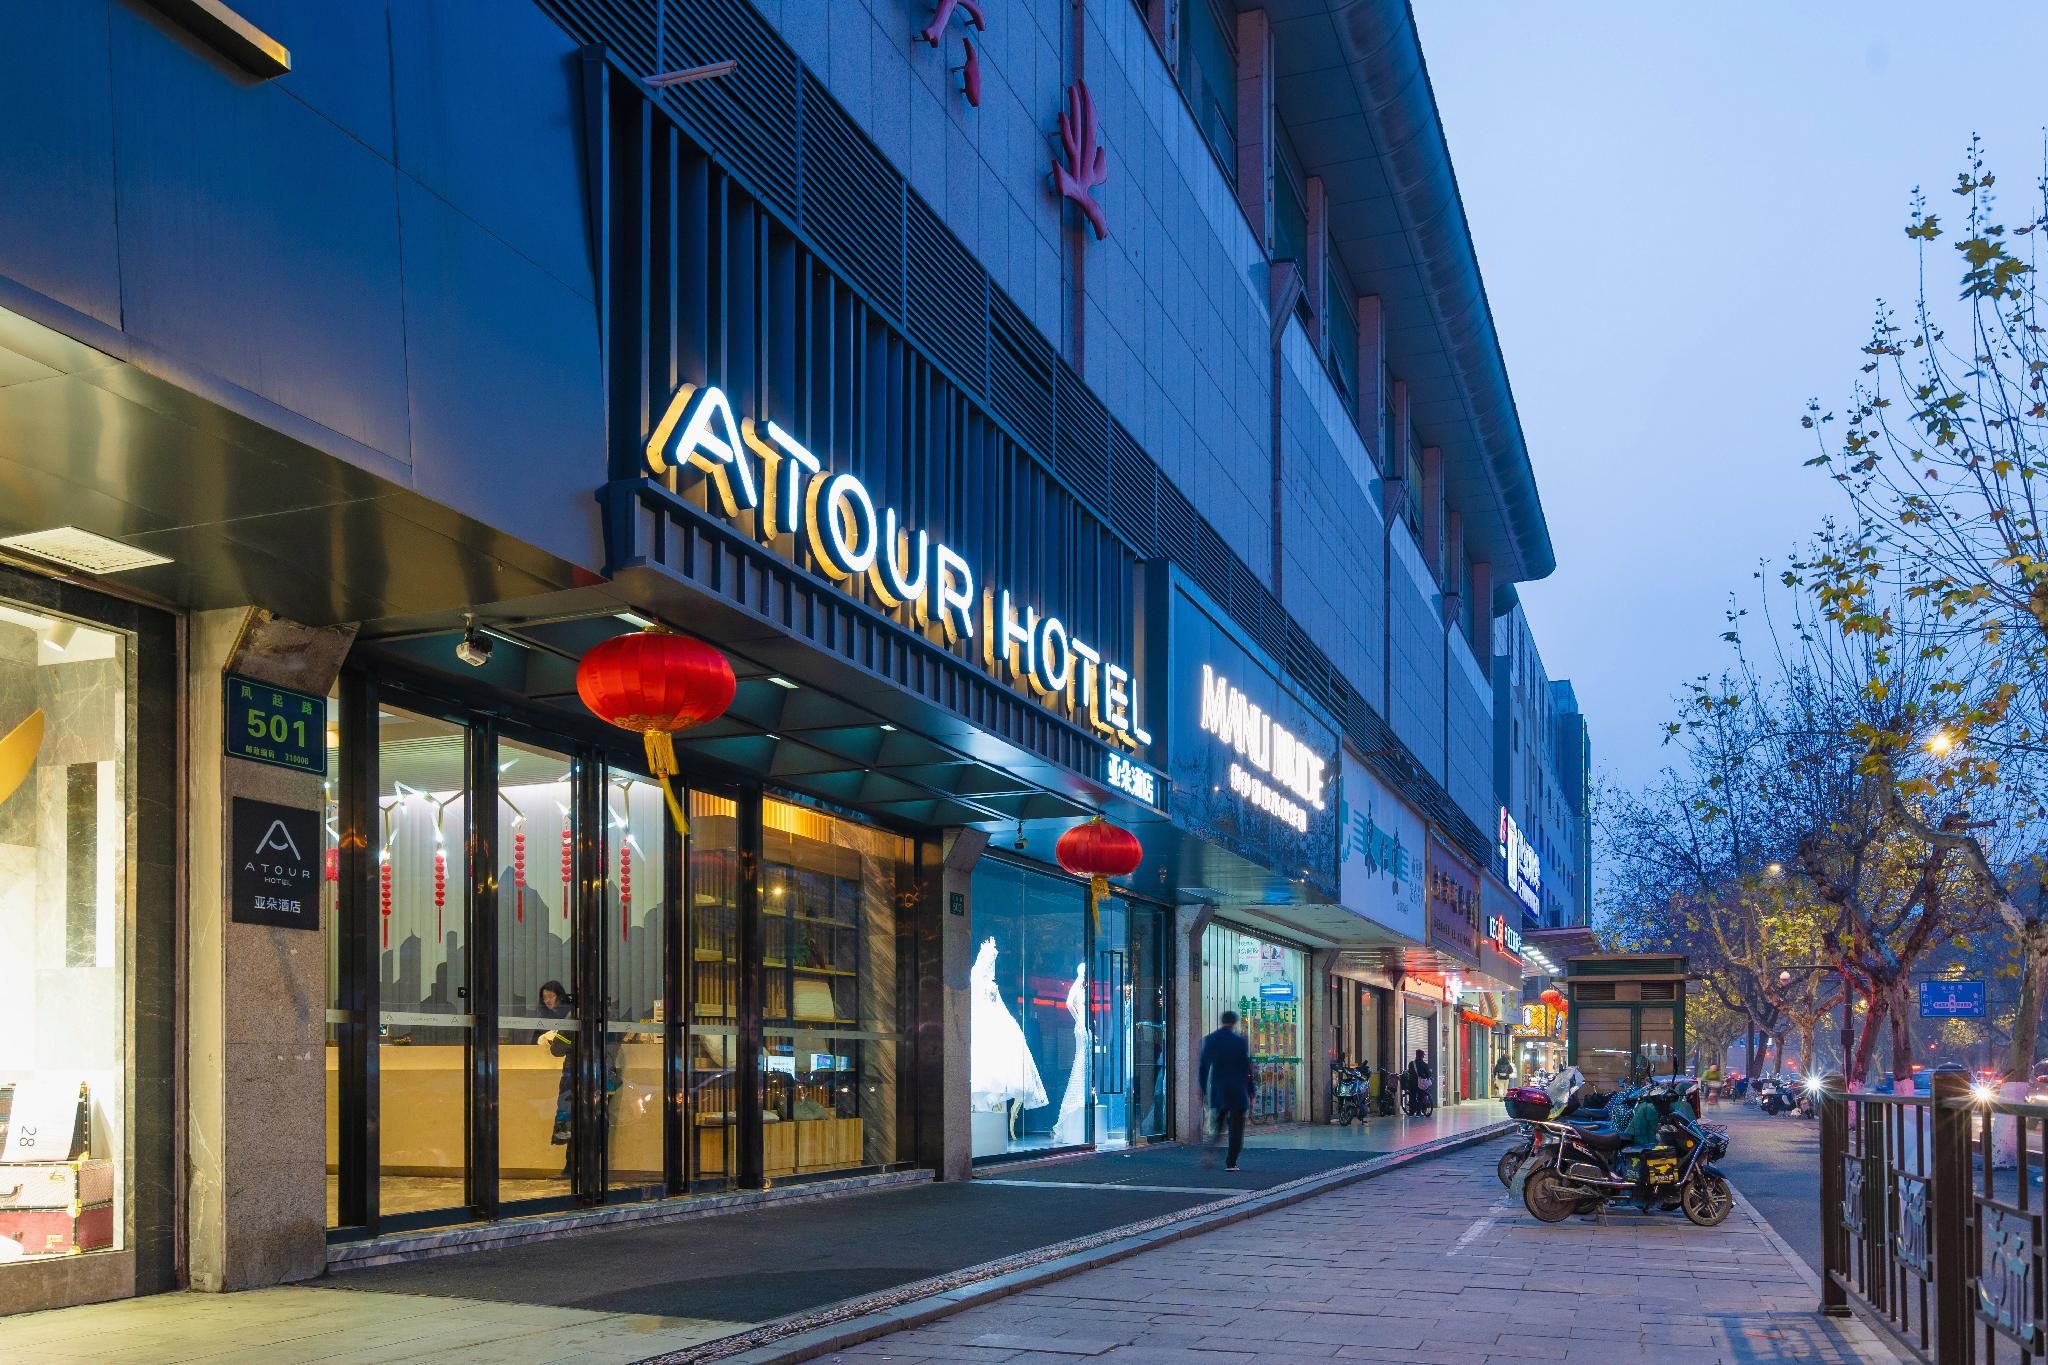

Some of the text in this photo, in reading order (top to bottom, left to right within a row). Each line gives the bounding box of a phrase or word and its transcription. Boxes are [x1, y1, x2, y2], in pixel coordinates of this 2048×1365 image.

[668, 385, 1153, 747] ATOUR HOTEL
[241, 685, 312, 715] 凤起路
[247, 708, 305, 748] 501
[1107, 752, 1154, 805] 亚朵酒店
[244, 861, 311, 879] ATOUR
[264, 876, 293, 887] HOTEL
[254, 895, 302, 914] 亚朵酒店
[19, 1124, 37, 1148] 28
